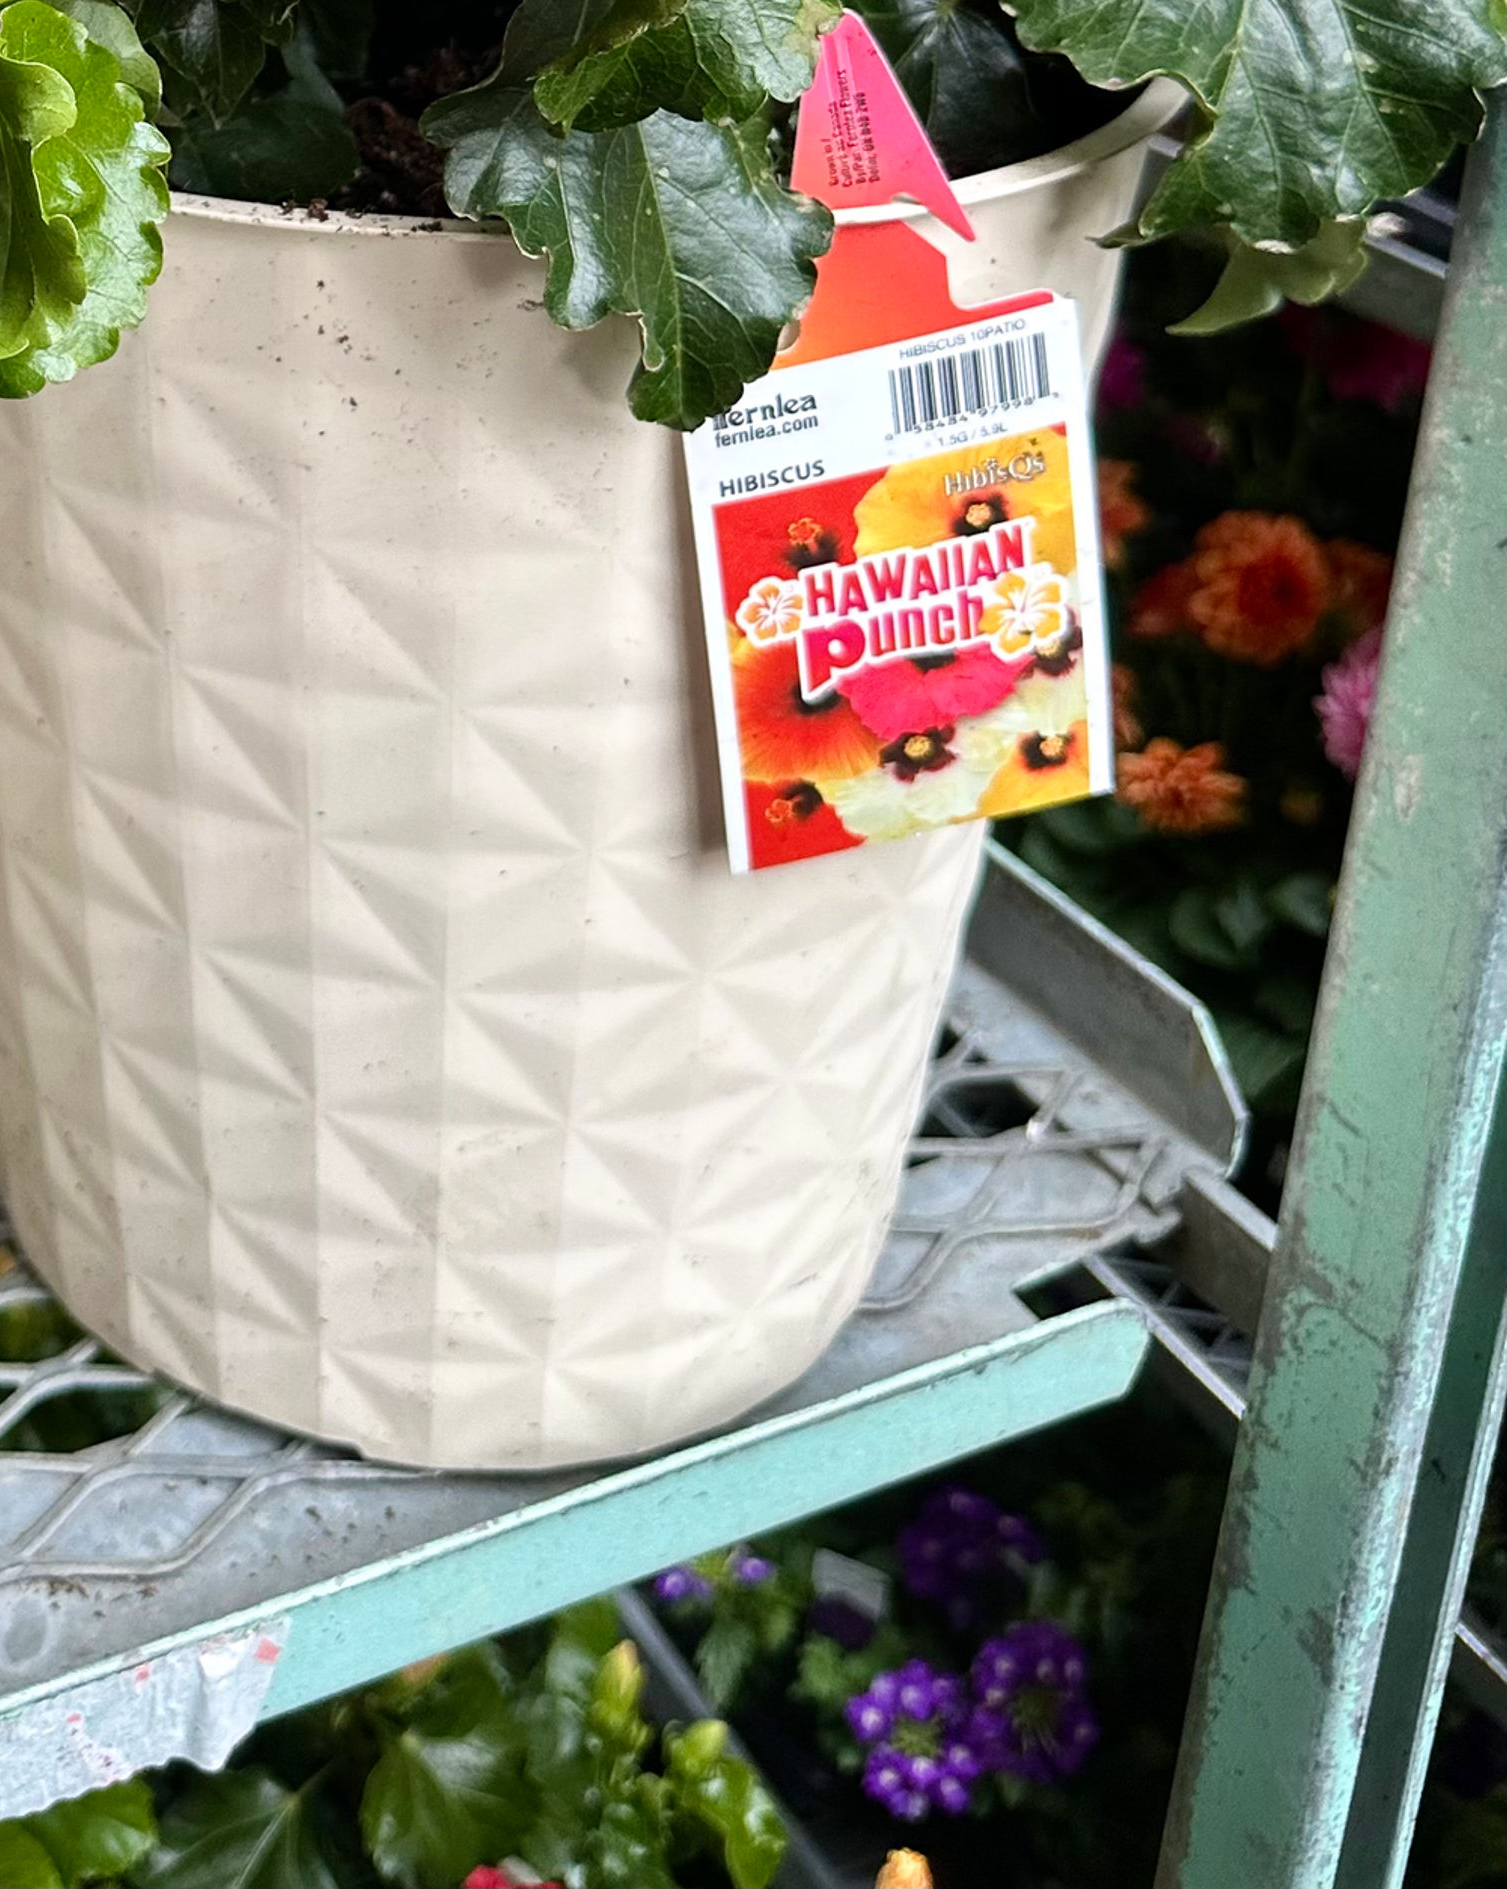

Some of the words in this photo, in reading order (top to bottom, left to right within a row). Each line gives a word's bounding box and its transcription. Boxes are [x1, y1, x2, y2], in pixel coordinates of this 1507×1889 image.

[899, 333, 966, 360] HIBISCUS
[715, 415, 818, 448] fernlea.com
[719, 459, 825, 498] HIBISCUS
[803, 523, 1026, 617] HAWAIIAN
